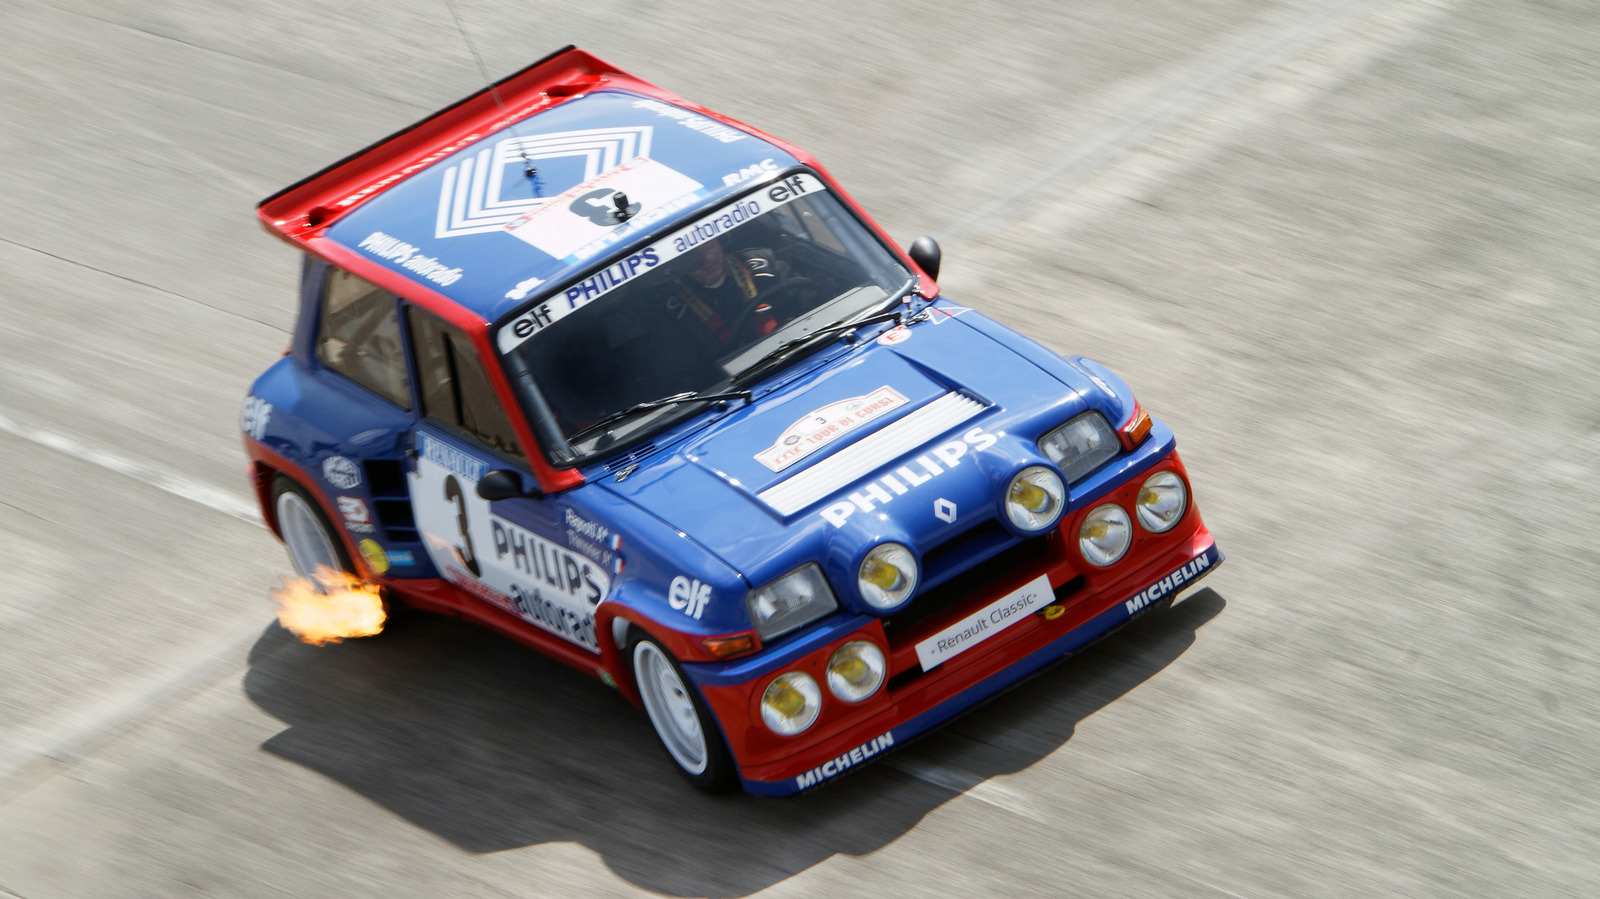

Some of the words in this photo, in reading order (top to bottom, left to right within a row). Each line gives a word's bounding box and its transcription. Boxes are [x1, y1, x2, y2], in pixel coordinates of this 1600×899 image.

[722, 158, 778, 187] RMC
[357, 231, 420, 264] PHILIPS
[401, 254, 464, 287] autoradio
[513, 305, 553, 338] elf
[564, 247, 661, 309] PHILIPS
[673, 199, 761, 252] autoradio
[769, 175, 807, 203] elf
[815, 416, 827, 425] 3
[819, 426, 997, 529] PHILIPS
[444, 474, 482, 577] 3
[490, 518, 601, 607] PHILIPS
[1125, 553, 1210, 615] MICHELIN
[669, 575, 713, 620] elf
[937, 617, 988, 653] Renault
[796, 731, 895, 790] MICHELIN
